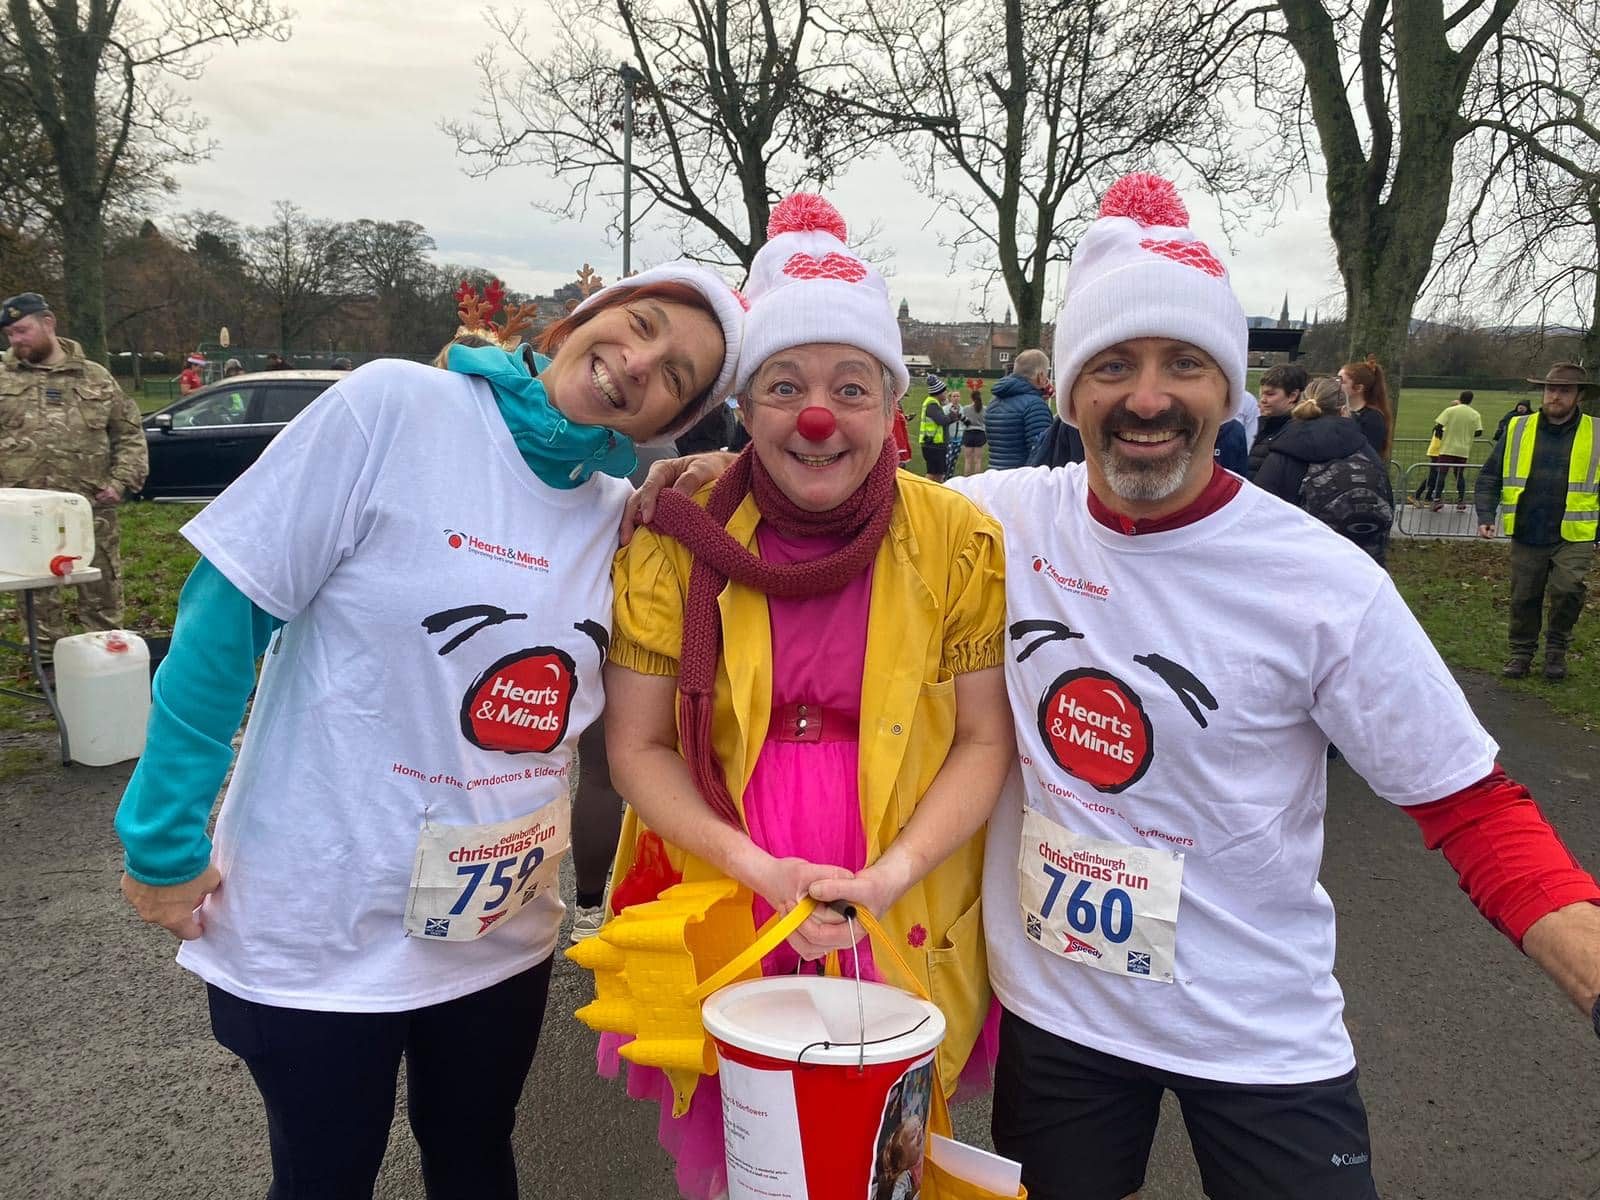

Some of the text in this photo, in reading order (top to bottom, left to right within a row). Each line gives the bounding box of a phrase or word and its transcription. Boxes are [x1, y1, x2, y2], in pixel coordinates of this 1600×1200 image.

[491, 677, 559, 705] Hearts
[1058, 693, 1132, 738] Hearts
[392, 763, 426, 781] Home
[430, 774, 443, 784] of
[446, 776, 463, 788] the
[524, 768, 531, 778] &
[449, 825, 555, 862] christmas run
[500, 823, 540, 844] edinburgh
[1039, 842, 1148, 890] christmas run
[1073, 851, 1125, 871] edinburgh
[449, 847, 544, 915] 759
[1039, 863, 1133, 943] 760
[1072, 941, 1102, 959] Speedy
